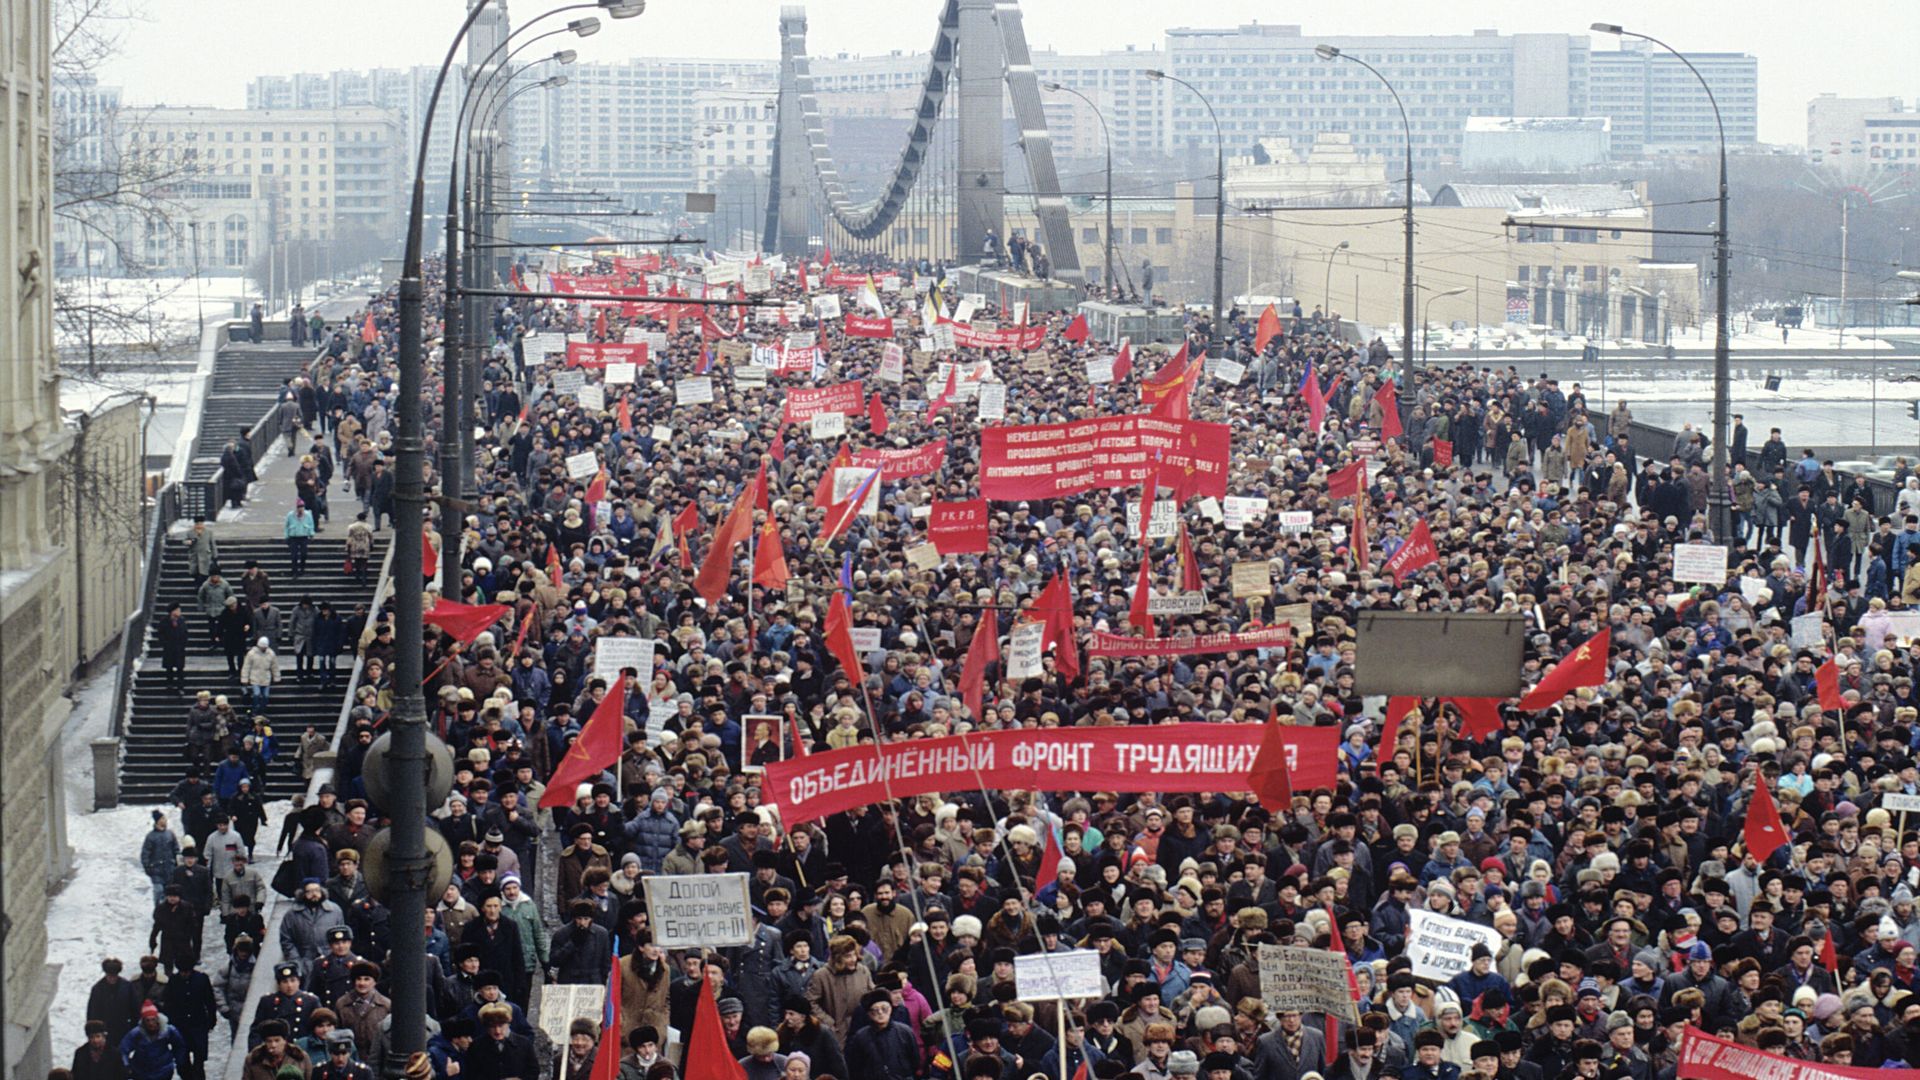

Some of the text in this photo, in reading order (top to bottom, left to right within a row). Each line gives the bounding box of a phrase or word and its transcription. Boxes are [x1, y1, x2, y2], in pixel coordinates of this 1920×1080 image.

[863, 456, 933, 473] СМОЛЕНСК
[789, 737, 1299, 804] ОБЪЕДИНЁННЫЙ ФРОНТ ТРУДЯЩИХЯ
[655, 901, 744, 918] САМОДЕРЖАВИЕ
